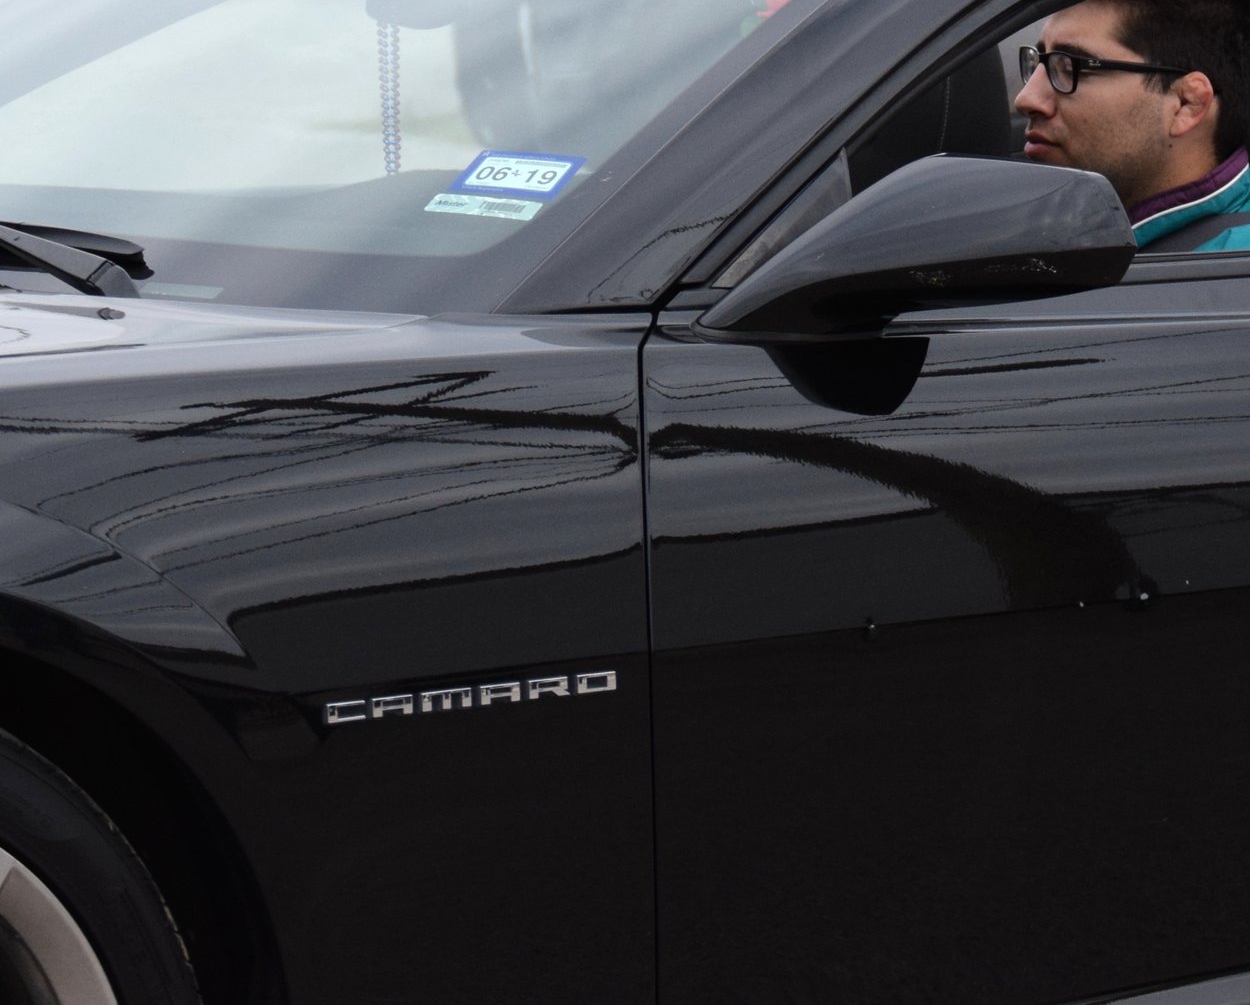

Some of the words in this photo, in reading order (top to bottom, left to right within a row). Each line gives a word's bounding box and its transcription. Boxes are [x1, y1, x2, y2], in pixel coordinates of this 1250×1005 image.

[475, 166, 512, 182] 06
[524, 169, 558, 185] 19
[324, 671, 617, 724] CAMARO
